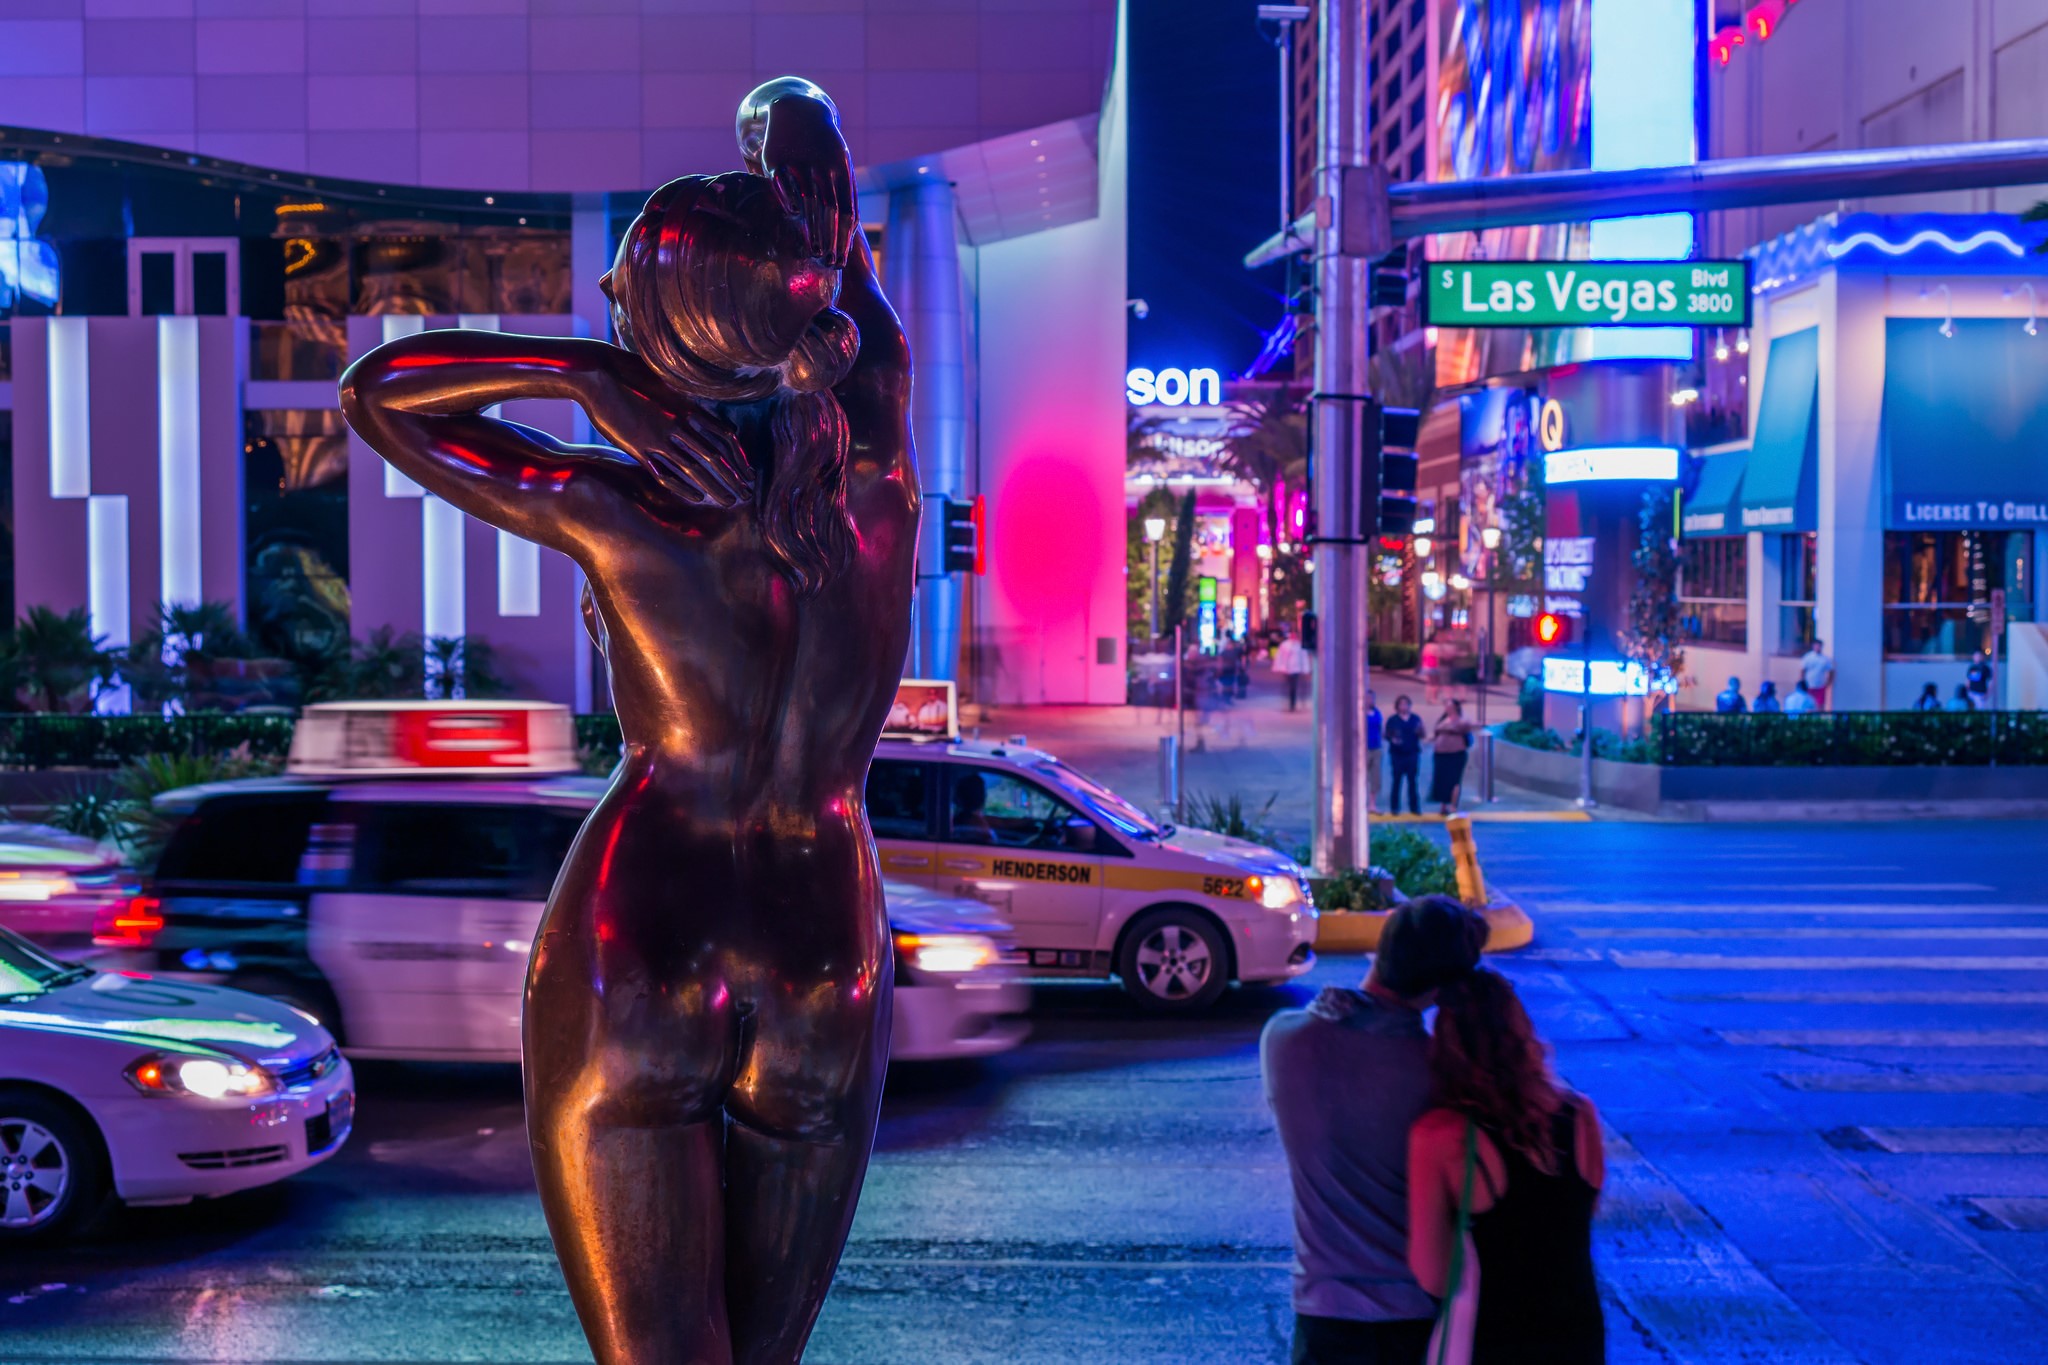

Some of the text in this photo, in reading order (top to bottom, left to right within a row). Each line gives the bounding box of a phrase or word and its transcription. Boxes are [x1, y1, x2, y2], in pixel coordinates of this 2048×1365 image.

[1441, 269, 1729, 322] S Las Vegas Blvd
[1687, 293, 1733, 313] 3800
[1541, 399, 1563, 451] Q
[993, 859, 1091, 883] HENDERSON
[1203, 876, 1244, 898] 5622
